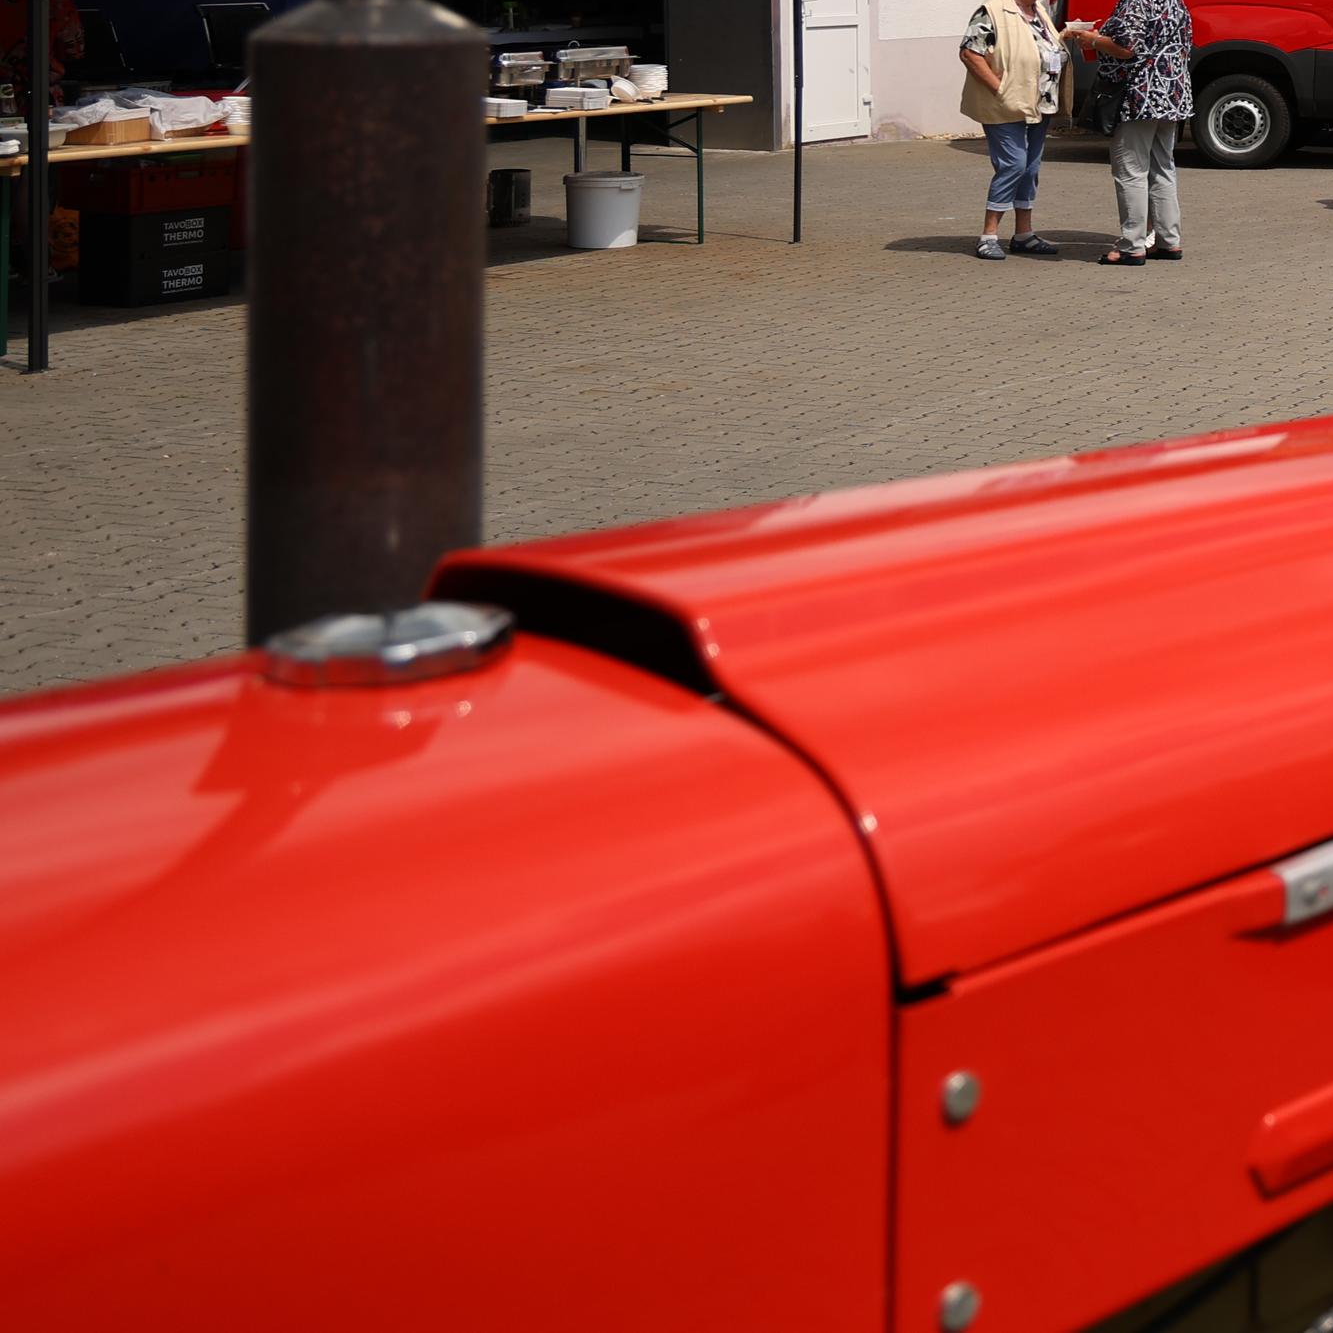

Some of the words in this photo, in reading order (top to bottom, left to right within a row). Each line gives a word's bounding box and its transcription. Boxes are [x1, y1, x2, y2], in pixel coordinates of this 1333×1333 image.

[163, 218, 204, 230] TAVOBOX
[164, 230, 204, 241] THERMO
[162, 264, 204, 277] TAVOBOX
[162, 276, 203, 289] THERMO
